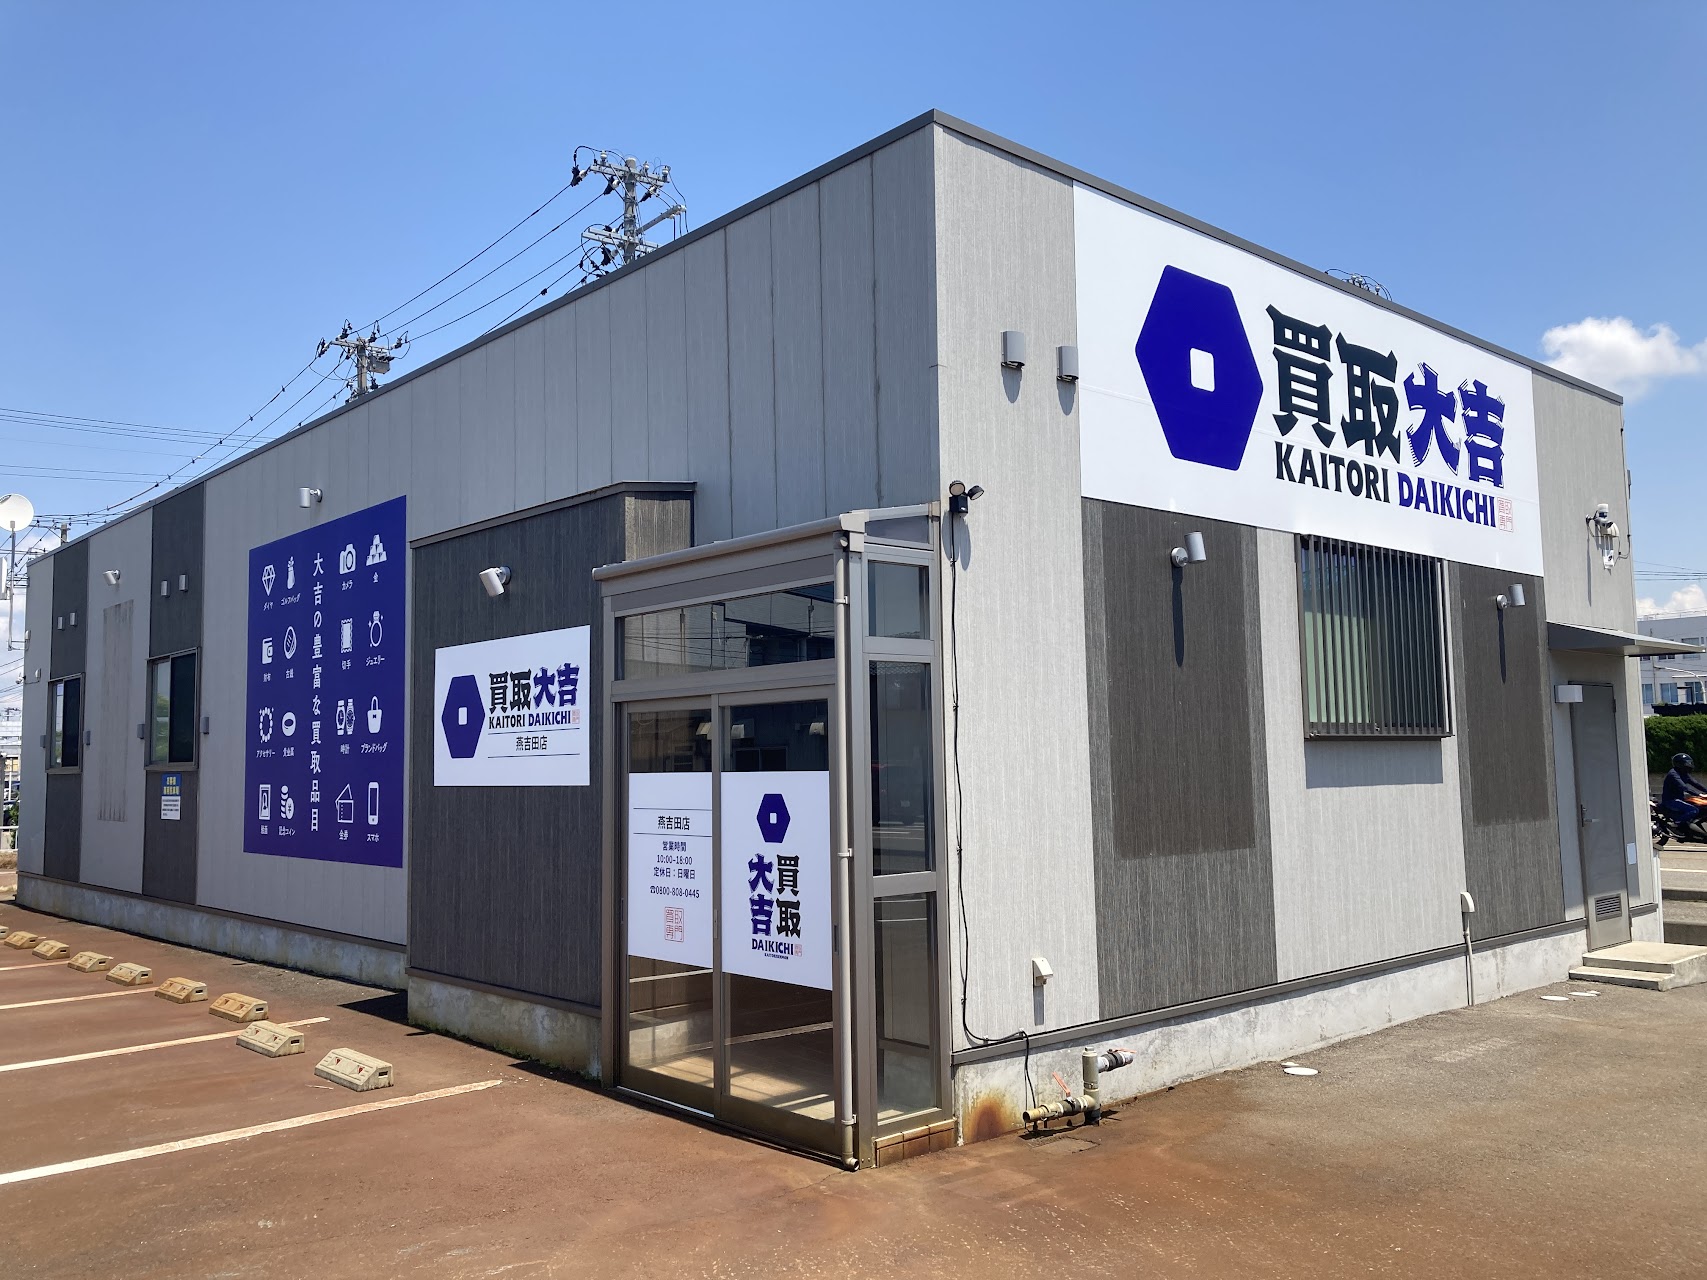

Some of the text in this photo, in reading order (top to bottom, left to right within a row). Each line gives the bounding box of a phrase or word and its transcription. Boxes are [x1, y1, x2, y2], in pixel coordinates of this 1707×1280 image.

[1265, 304, 1506, 488] 買取大吉
[1274, 440, 1497, 528] KAITORI DAIKICHI
[341, 580, 353, 591] カメラ
[365, 655, 386, 667] ジュエリー
[309, 553, 325, 832] 大吉の豊富な買取品目
[488, 662, 580, 715] 買取大吉
[488, 713, 526, 730] KAITORI
[528, 710, 571, 727] DAIKICHI
[515, 735, 548, 751] 燕吉田店
[657, 815, 690, 831] 燕吉田店
[366, 833, 380, 842] スマホ
[662, 840, 687, 852] 営業時間
[747, 853, 775, 937] 大吉
[776, 854, 802, 939] 買取
[751, 938, 794, 956] DAIKICHI
